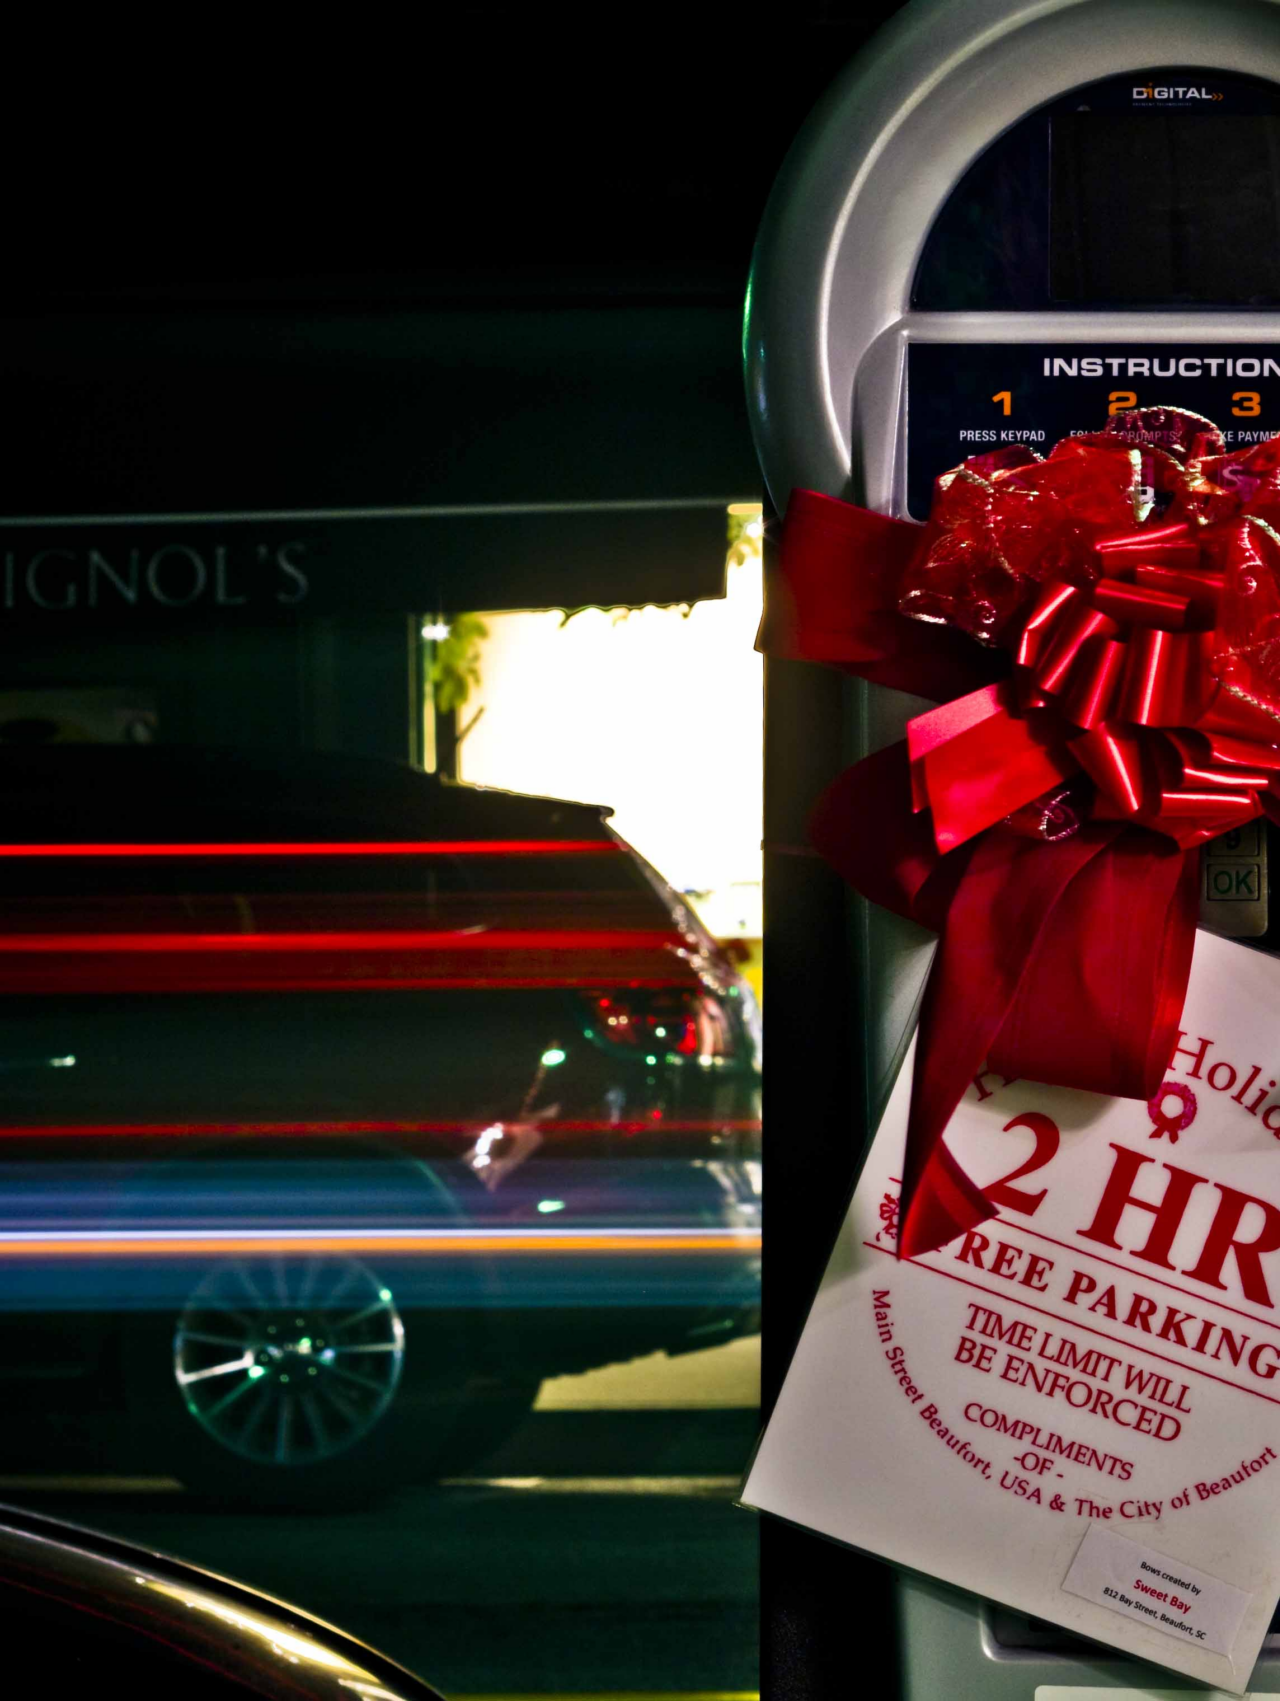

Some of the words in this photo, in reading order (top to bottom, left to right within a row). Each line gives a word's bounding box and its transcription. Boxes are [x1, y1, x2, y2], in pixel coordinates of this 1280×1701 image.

[991, 391, 1012, 416] 1
[1108, 391, 1138, 417] 2
[1231, 391, 1262, 417] 3
[959, 430, 997, 441] PRESS
[1000, 430, 1045, 441] KEYPAD
[1213, 870, 1254, 895] OK
[980, 1112, 1060, 1217] 2
[935, 1230, 1055, 1293] REE
[965, 1303, 1038, 1352] TIME
[1037, 1332, 1122, 1382] LIMIT
[1123, 1364, 1192, 1414] WILL
[872, 1289, 894, 1344] Main
[885, 1346, 925, 1404] Street
[919, 1403, 992, 1480] Beaufort,
[1000, 1470, 1042, 1505] USA
[1049, 1493, 1066, 1512] &
[1074, 1497, 1113, 1519] The
[1119, 1500, 1163, 1520] City
[1171, 1488, 1188, 1510] of
[1194, 1446, 1278, 1501] Beaufort
[954, 1336, 998, 1373] BE
[1000, 1354, 1182, 1442] ENFORCED
[964, 1402, 1135, 1481] COMPLIMENTS
[1133, 1579, 1168, 1602] Sweet
[1169, 1595, 1191, 1614] Bay
[1140, 1561, 1160, 1575] Bows
[1161, 1572, 1191, 1589] created
[1191, 1584, 1201, 1595] by
[1103, 1586, 1118, 1598] 812
[1118, 1594, 1133, 1606] Bay
[1133, 1601, 1158, 1619] Street,
[1159, 1613, 1193, 1635] Beaufort,
[1195, 1630, 1206, 1640] SC
